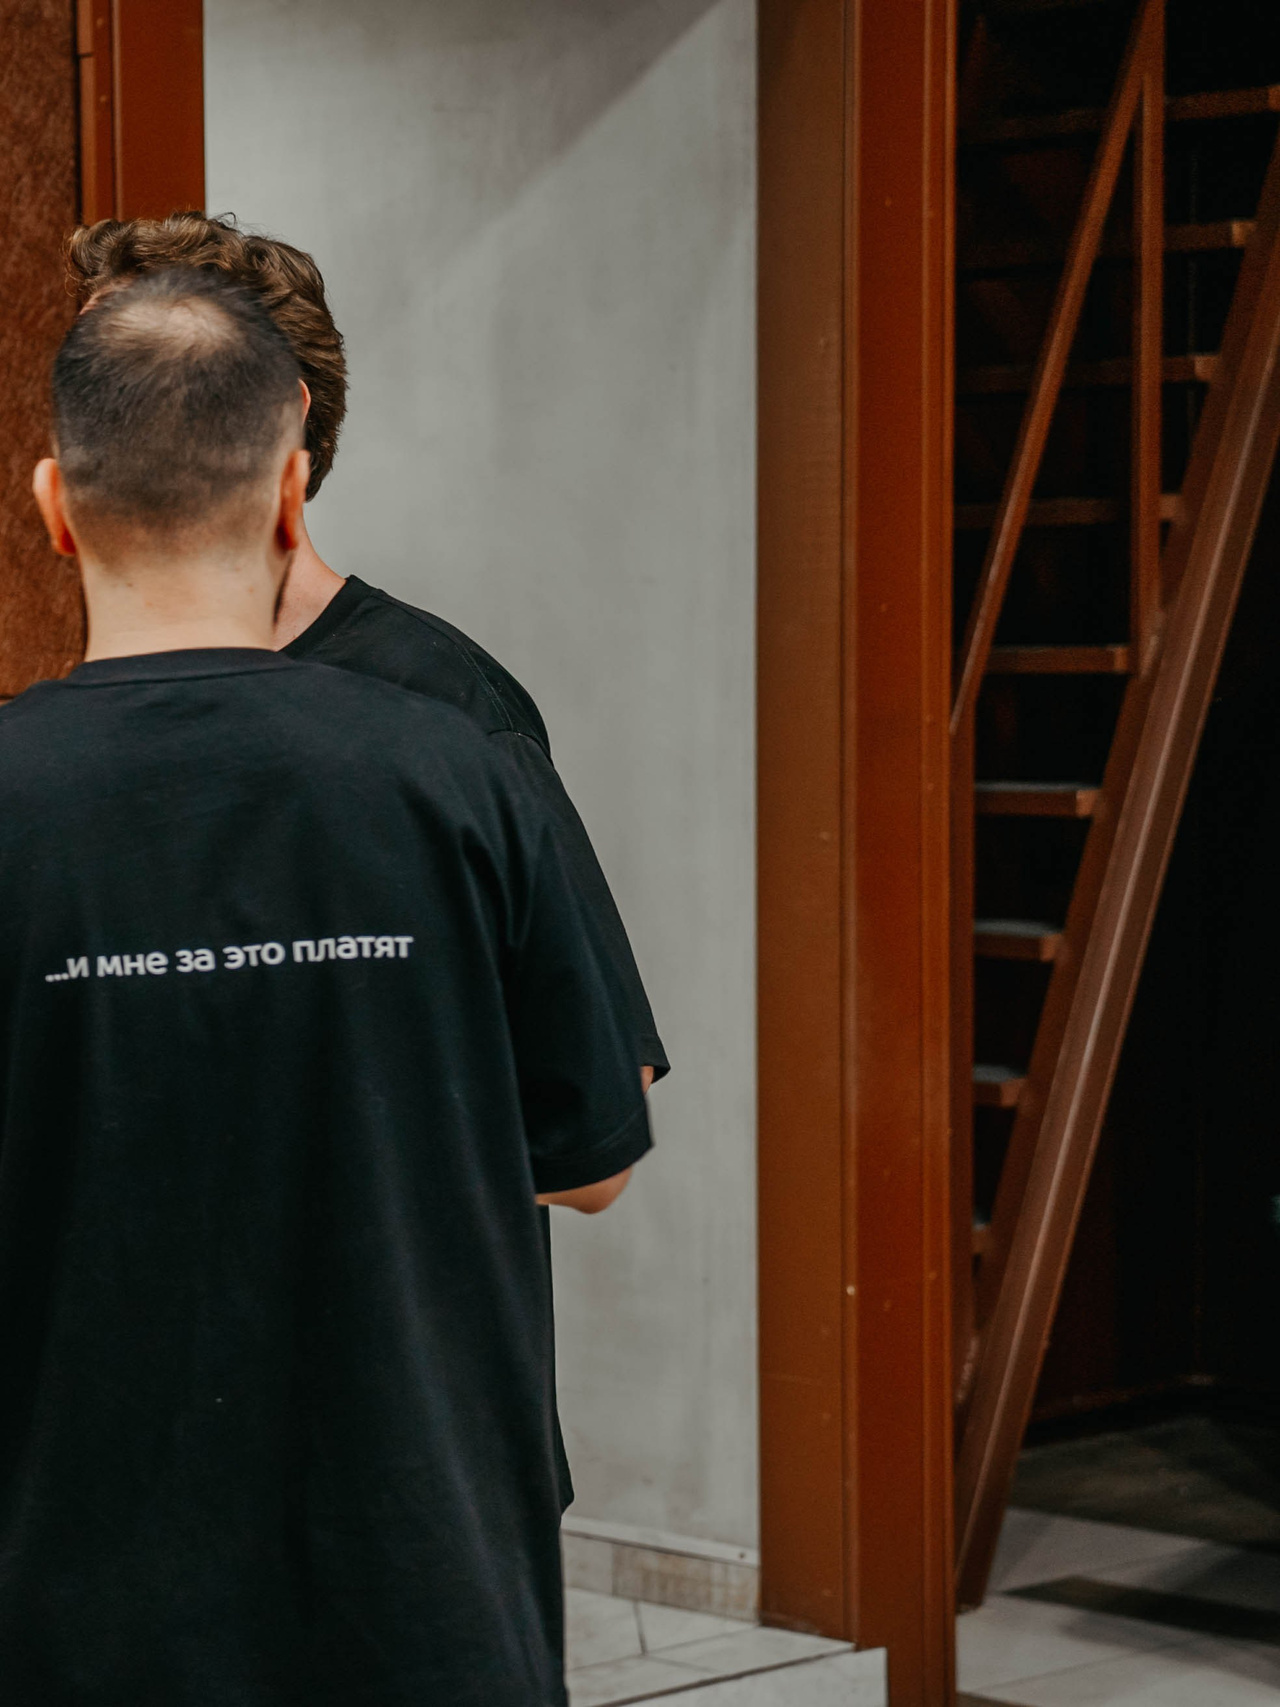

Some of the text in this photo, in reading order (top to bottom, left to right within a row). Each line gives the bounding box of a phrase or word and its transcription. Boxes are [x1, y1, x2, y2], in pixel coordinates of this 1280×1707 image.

[97, 948, 169, 977] мне
[175, 946, 216, 973] за
[222, 938, 286, 970] это
[292, 934, 414, 963] платят
